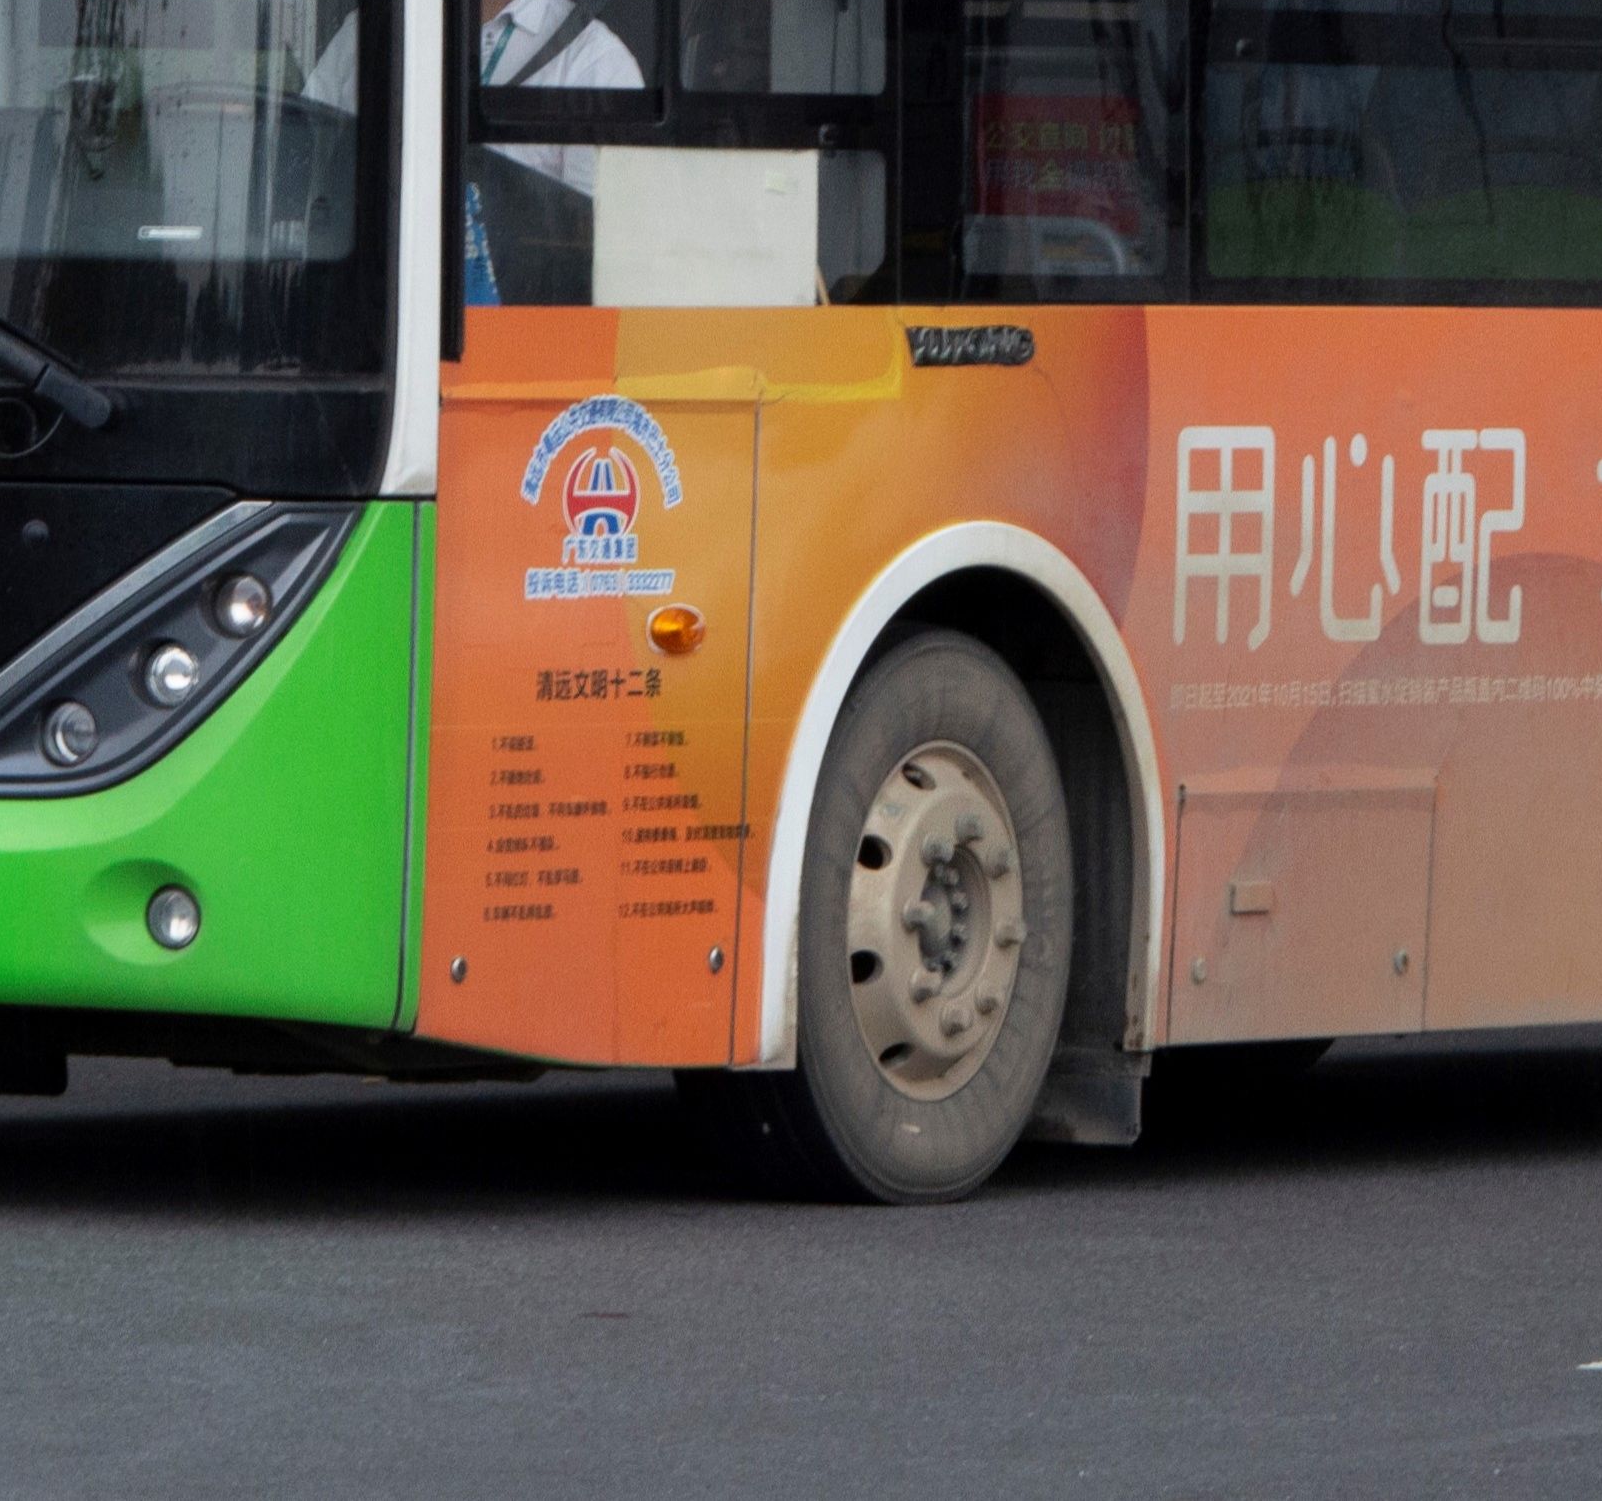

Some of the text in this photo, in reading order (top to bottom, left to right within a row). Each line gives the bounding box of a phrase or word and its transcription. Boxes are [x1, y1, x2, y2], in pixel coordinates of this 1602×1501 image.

[1172, 425, 1527, 652] 用心配
[536, 668, 662, 701] 清远文明十二条
